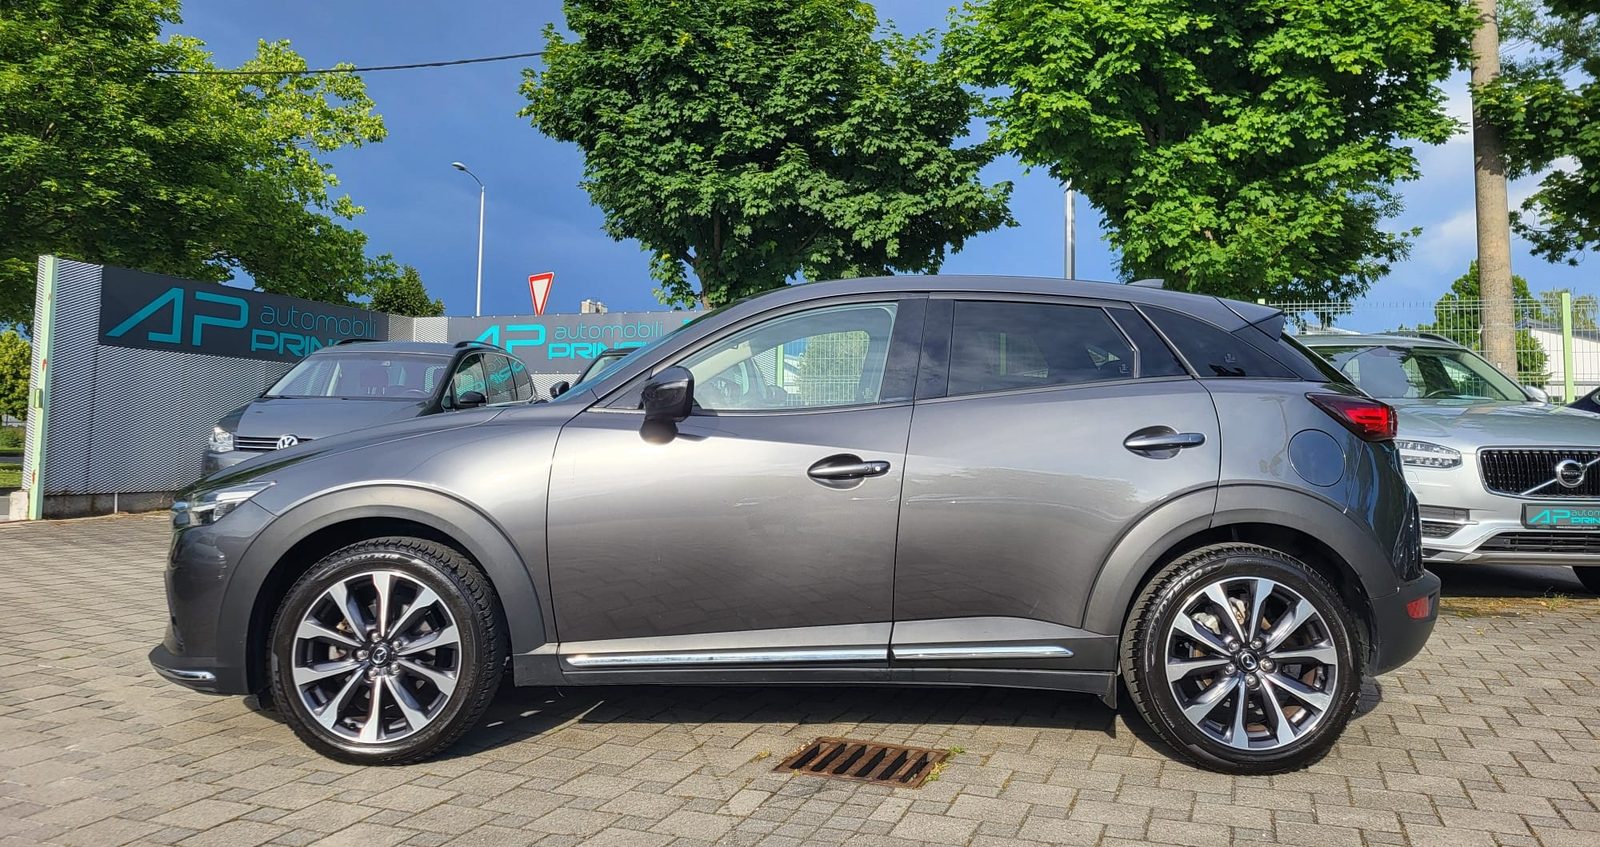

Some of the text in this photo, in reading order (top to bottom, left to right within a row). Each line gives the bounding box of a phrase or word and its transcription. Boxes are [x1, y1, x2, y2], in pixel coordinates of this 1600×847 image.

[105, 286, 249, 346] AP
[260, 303, 377, 338] automobili
[554, 321, 663, 340] automobili
[251, 328, 340, 357] PRIN
[474, 324, 546, 354] AP
[1529, 509, 1571, 524] AP
